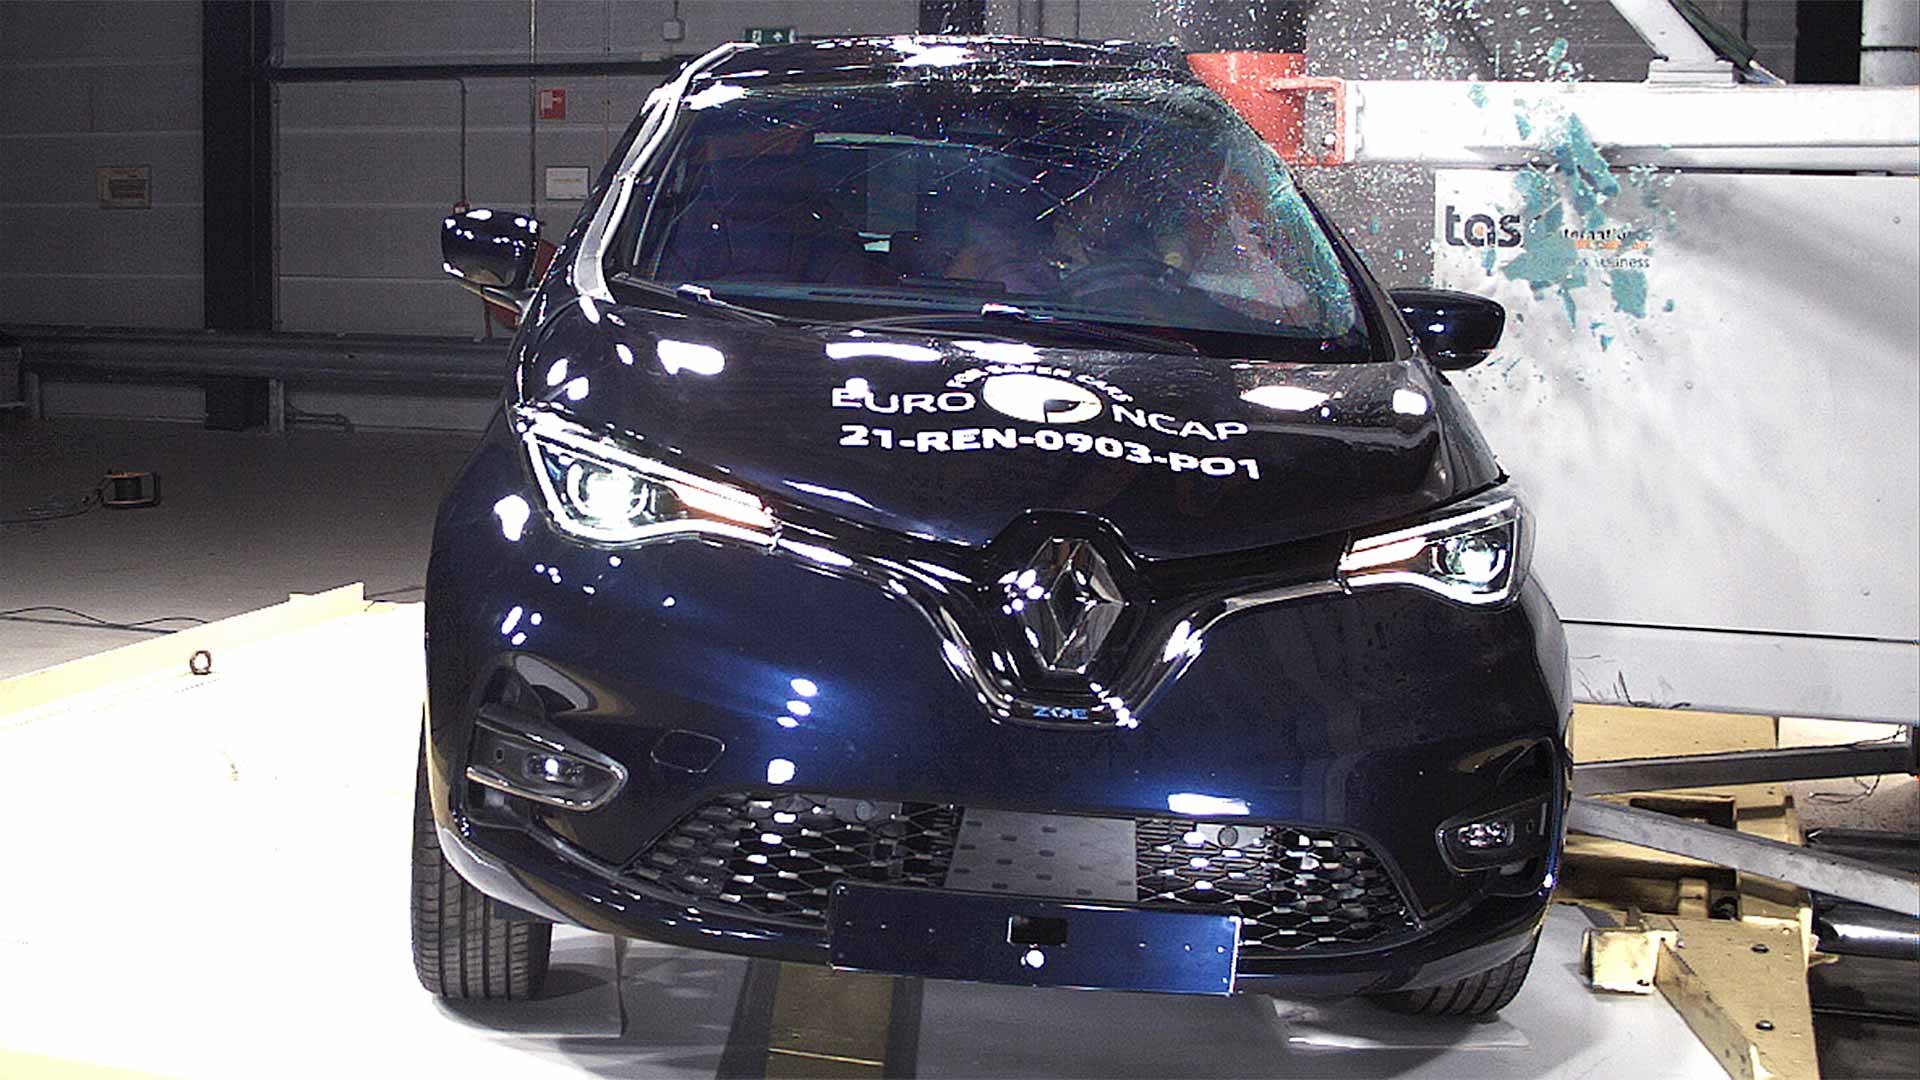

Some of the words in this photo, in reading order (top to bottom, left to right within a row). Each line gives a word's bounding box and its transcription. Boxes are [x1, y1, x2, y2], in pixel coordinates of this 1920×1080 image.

[1445, 205, 1522, 248] tas
[832, 387, 977, 414] EURO
[1111, 403, 1249, 441] NCAP
